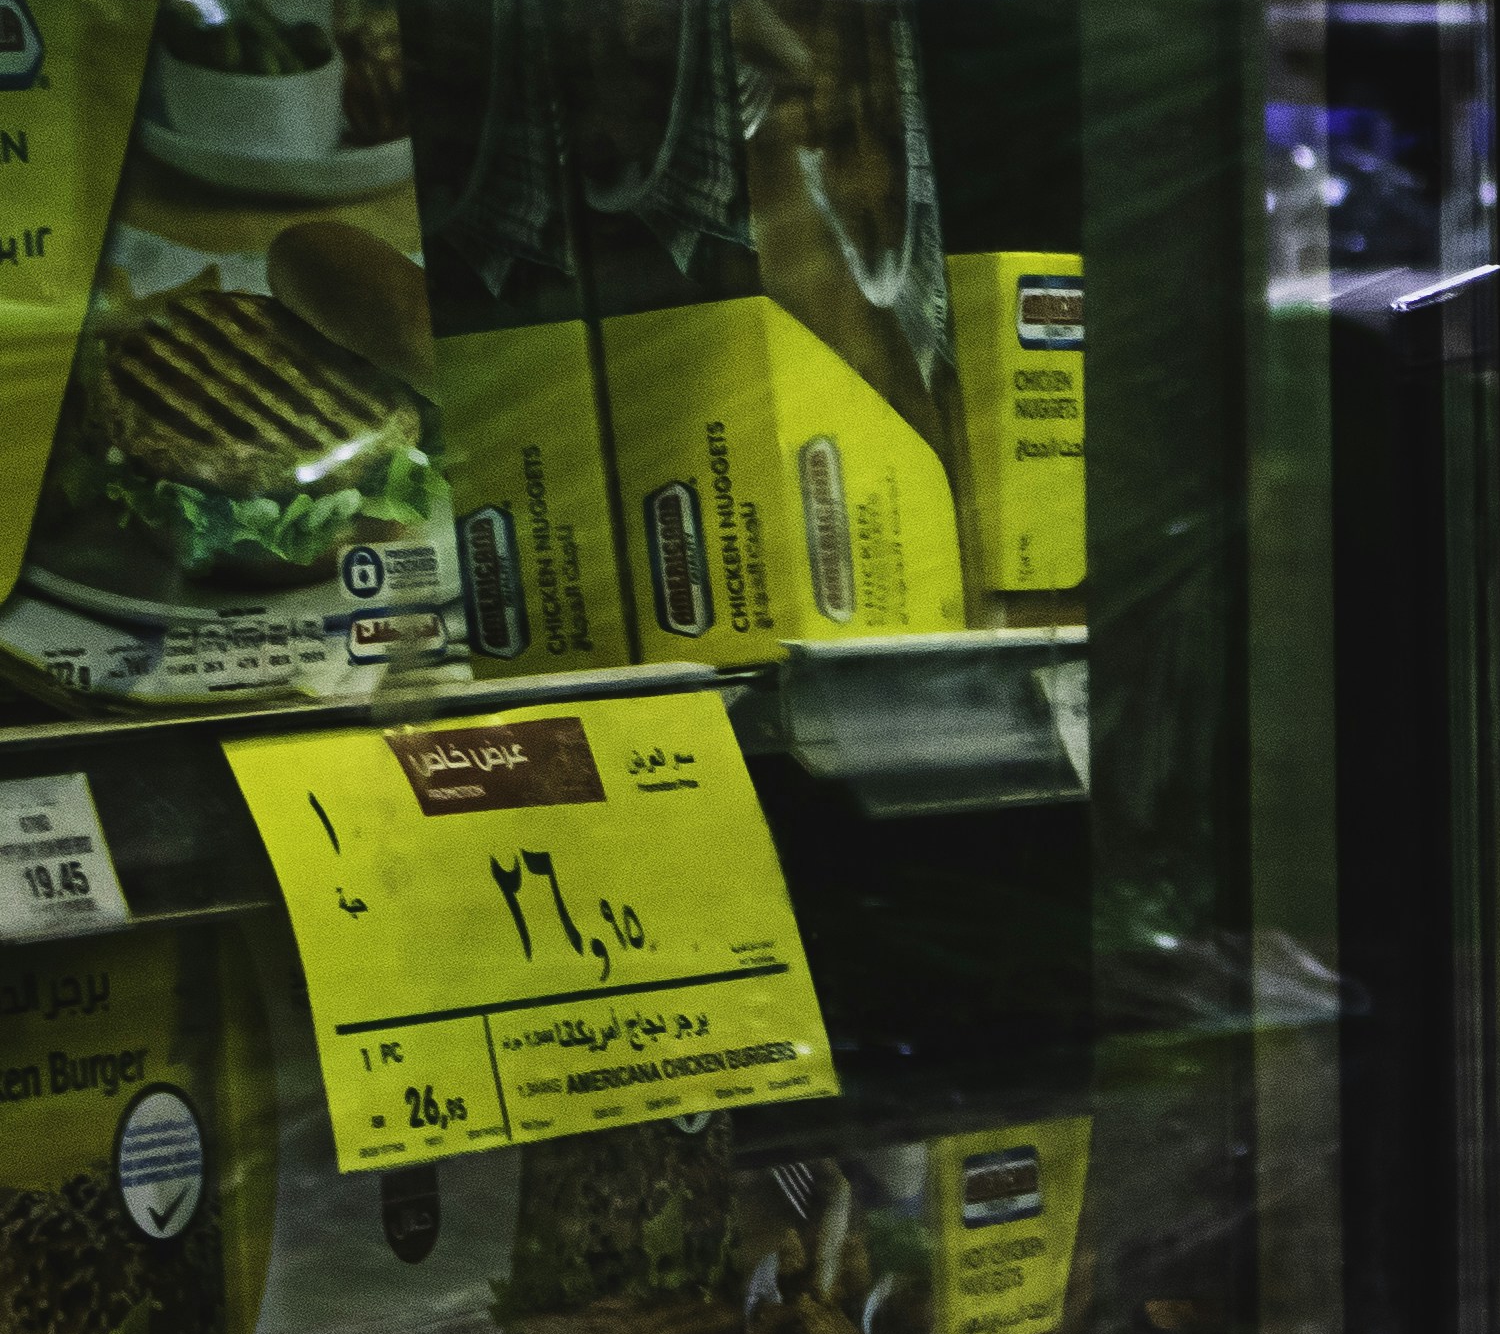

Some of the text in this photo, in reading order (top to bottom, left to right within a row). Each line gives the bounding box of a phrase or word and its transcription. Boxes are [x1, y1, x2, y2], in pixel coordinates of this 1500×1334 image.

[522, 444, 567, 656] CHICKEN NUGGETS
[706, 420, 750, 634] CHICKEN NUGGETS
[408, 740, 529, 777] عرض خاص
[25, 860, 91, 899] 19.45
[48, 1047, 149, 1097] Burger
[379, 1041, 404, 1065] PC
[566, 1061, 663, 1095] AMERICANA
[661, 1051, 725, 1081] CHICKEN
[724, 1039, 798, 1070] BURGERS
